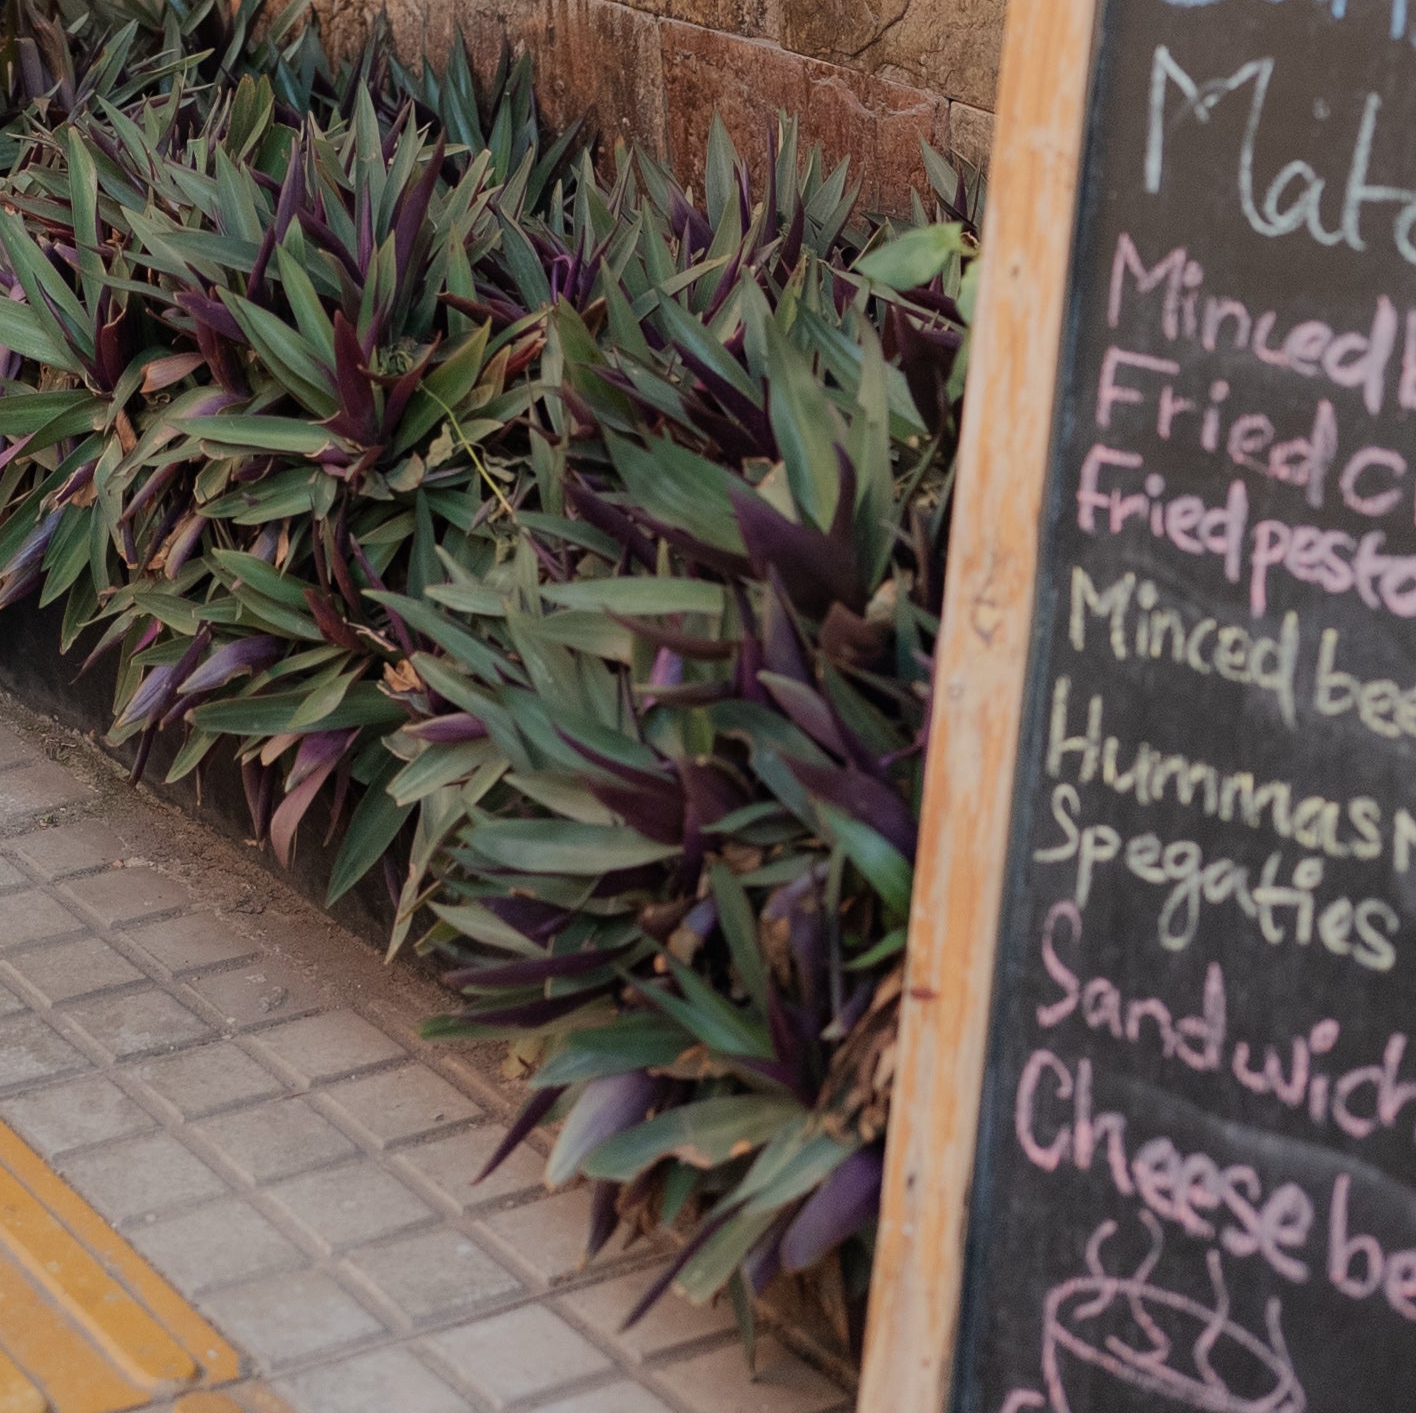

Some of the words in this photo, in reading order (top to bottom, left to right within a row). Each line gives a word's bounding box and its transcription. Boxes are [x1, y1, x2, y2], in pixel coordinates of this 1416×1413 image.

[1107, 232, 1397, 416] Minced
[1077, 443, 1249, 583] Fried
[1096, 345, 1338, 509] Fried
[1339, 445, 1416, 518] C
[1069, 566, 1300, 730] Minced
[1015, 1048, 1313, 1284] Cheese
